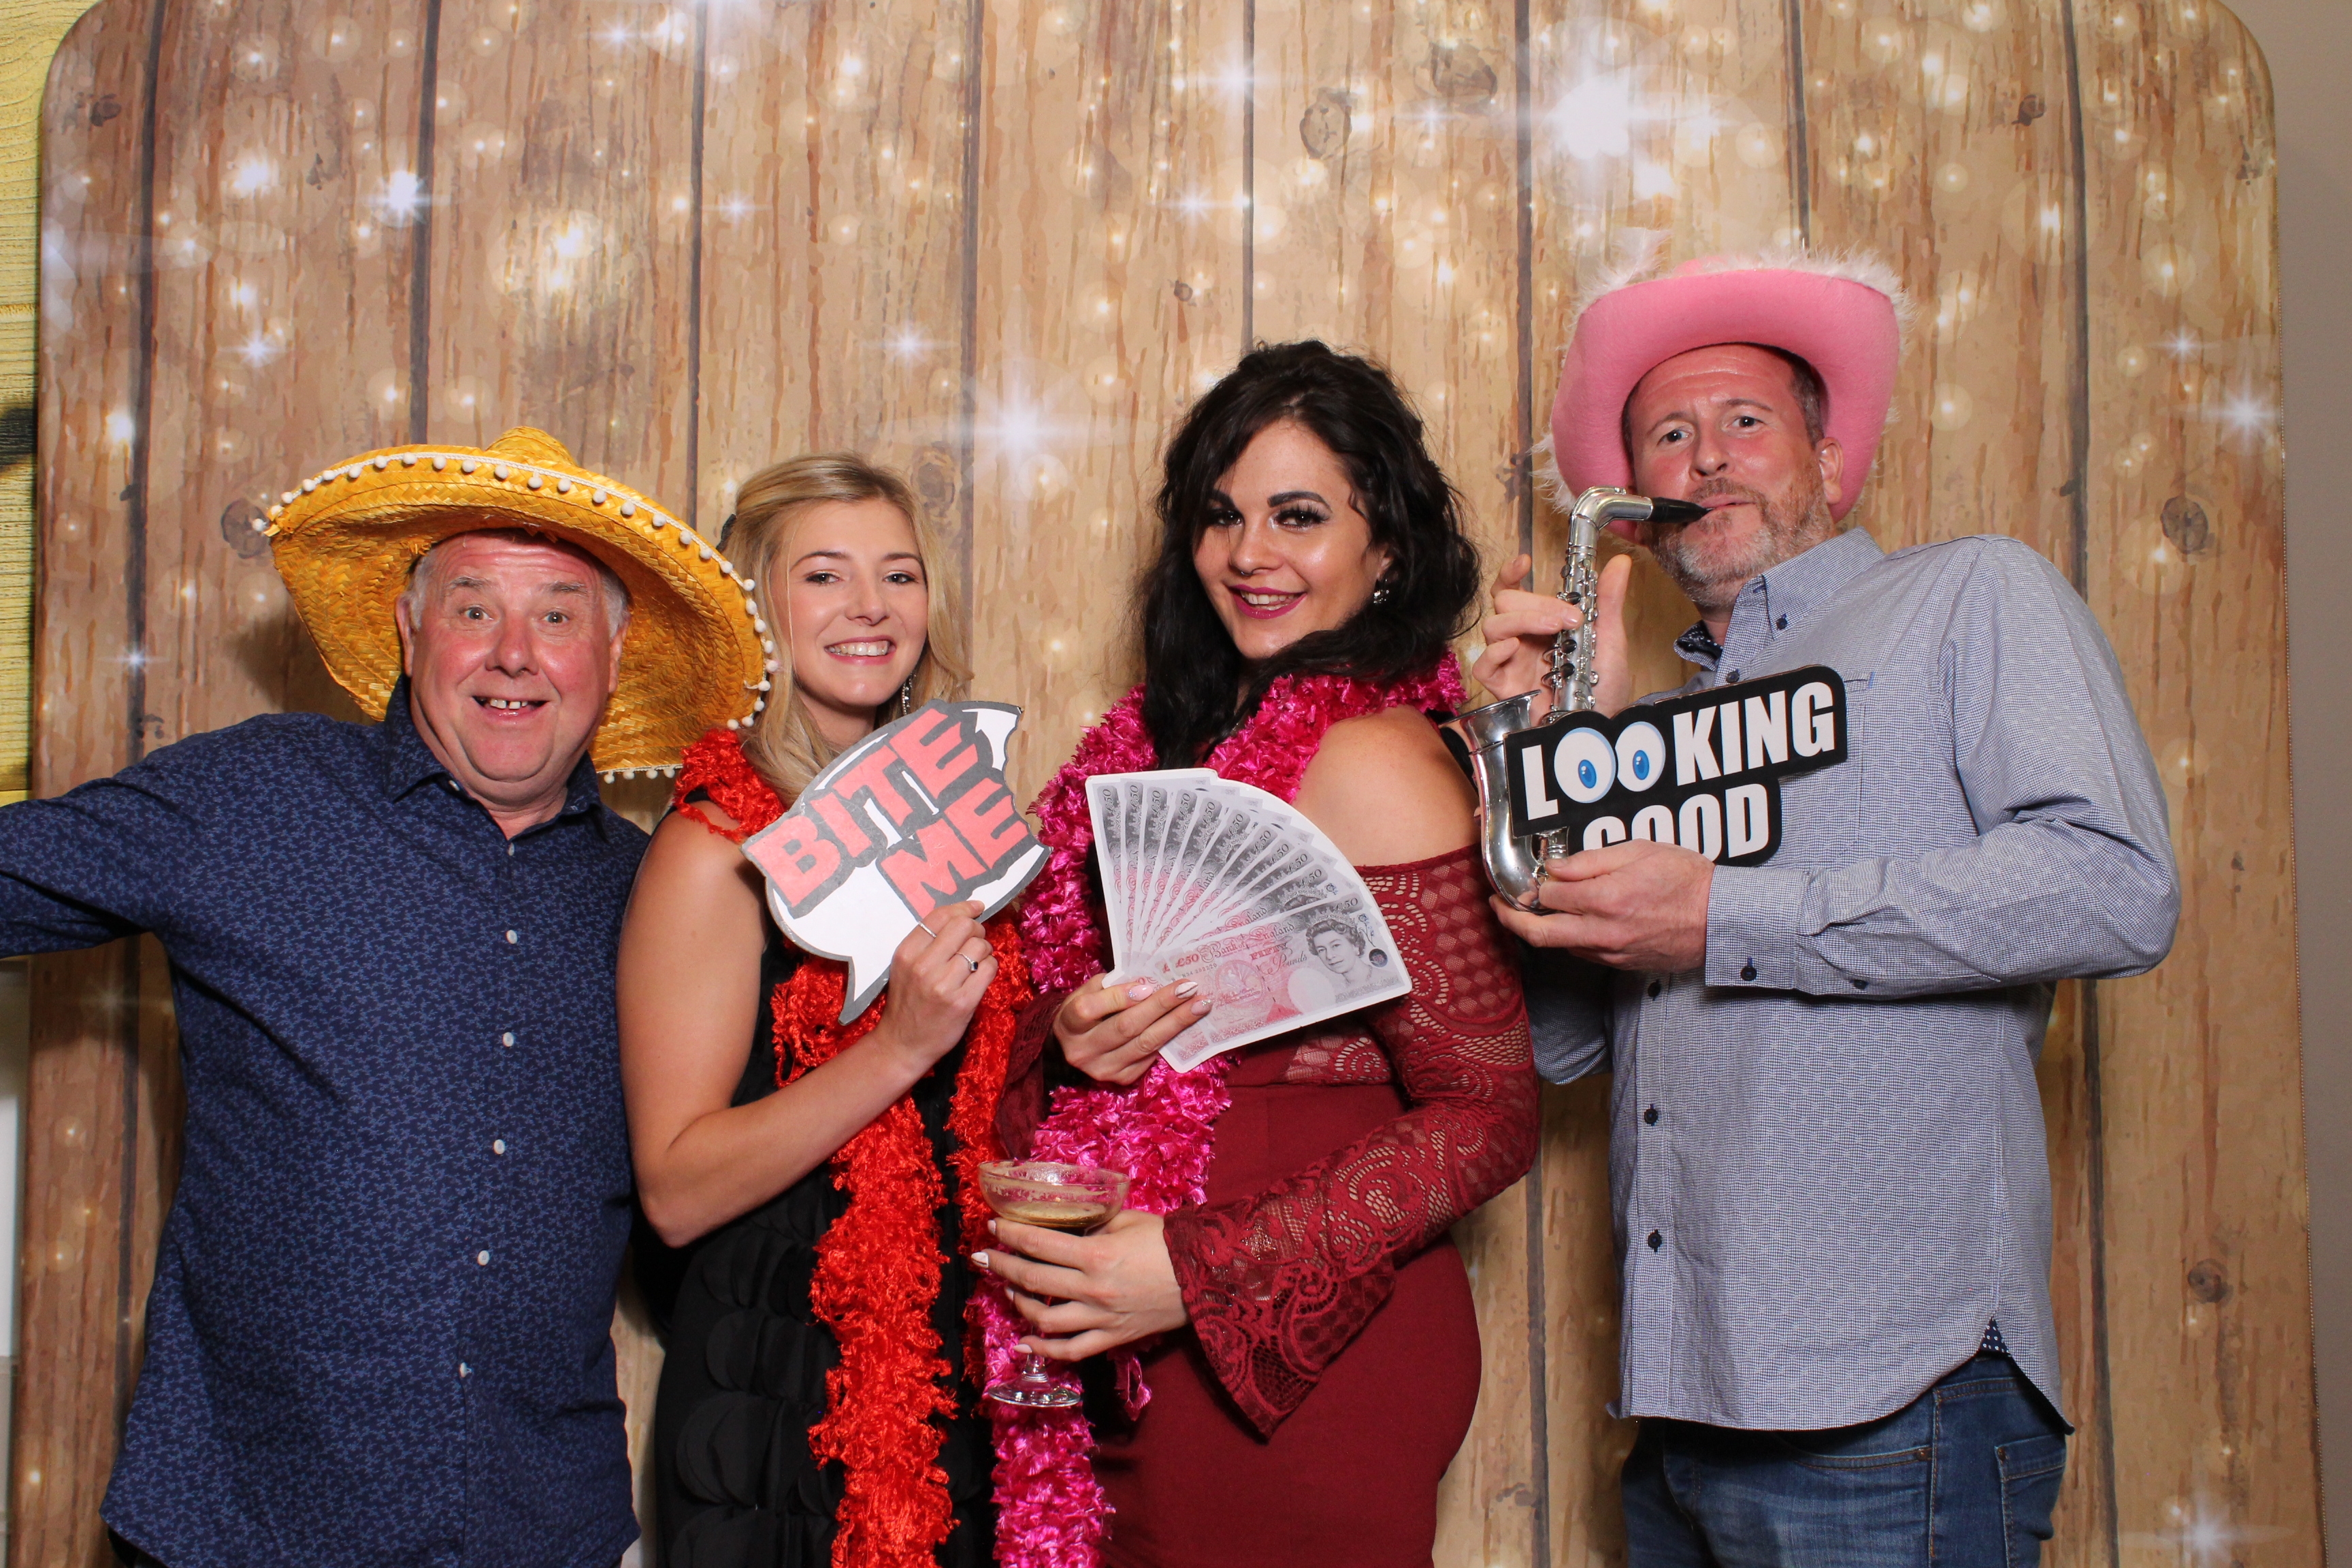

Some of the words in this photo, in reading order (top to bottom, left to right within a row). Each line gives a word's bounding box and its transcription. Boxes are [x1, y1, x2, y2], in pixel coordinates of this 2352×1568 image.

[1522, 682, 1835, 820] LOOKING
[748, 708, 978, 907] BITE
[880, 777, 1029, 921] ME
[1334, 898, 1358, 911] £50
[1175, 953, 1199, 968] £50
[1197, 938, 1238, 963] Bank
[1247, 922, 1294, 946] England
[1249, 942, 1288, 960] FIFTY
